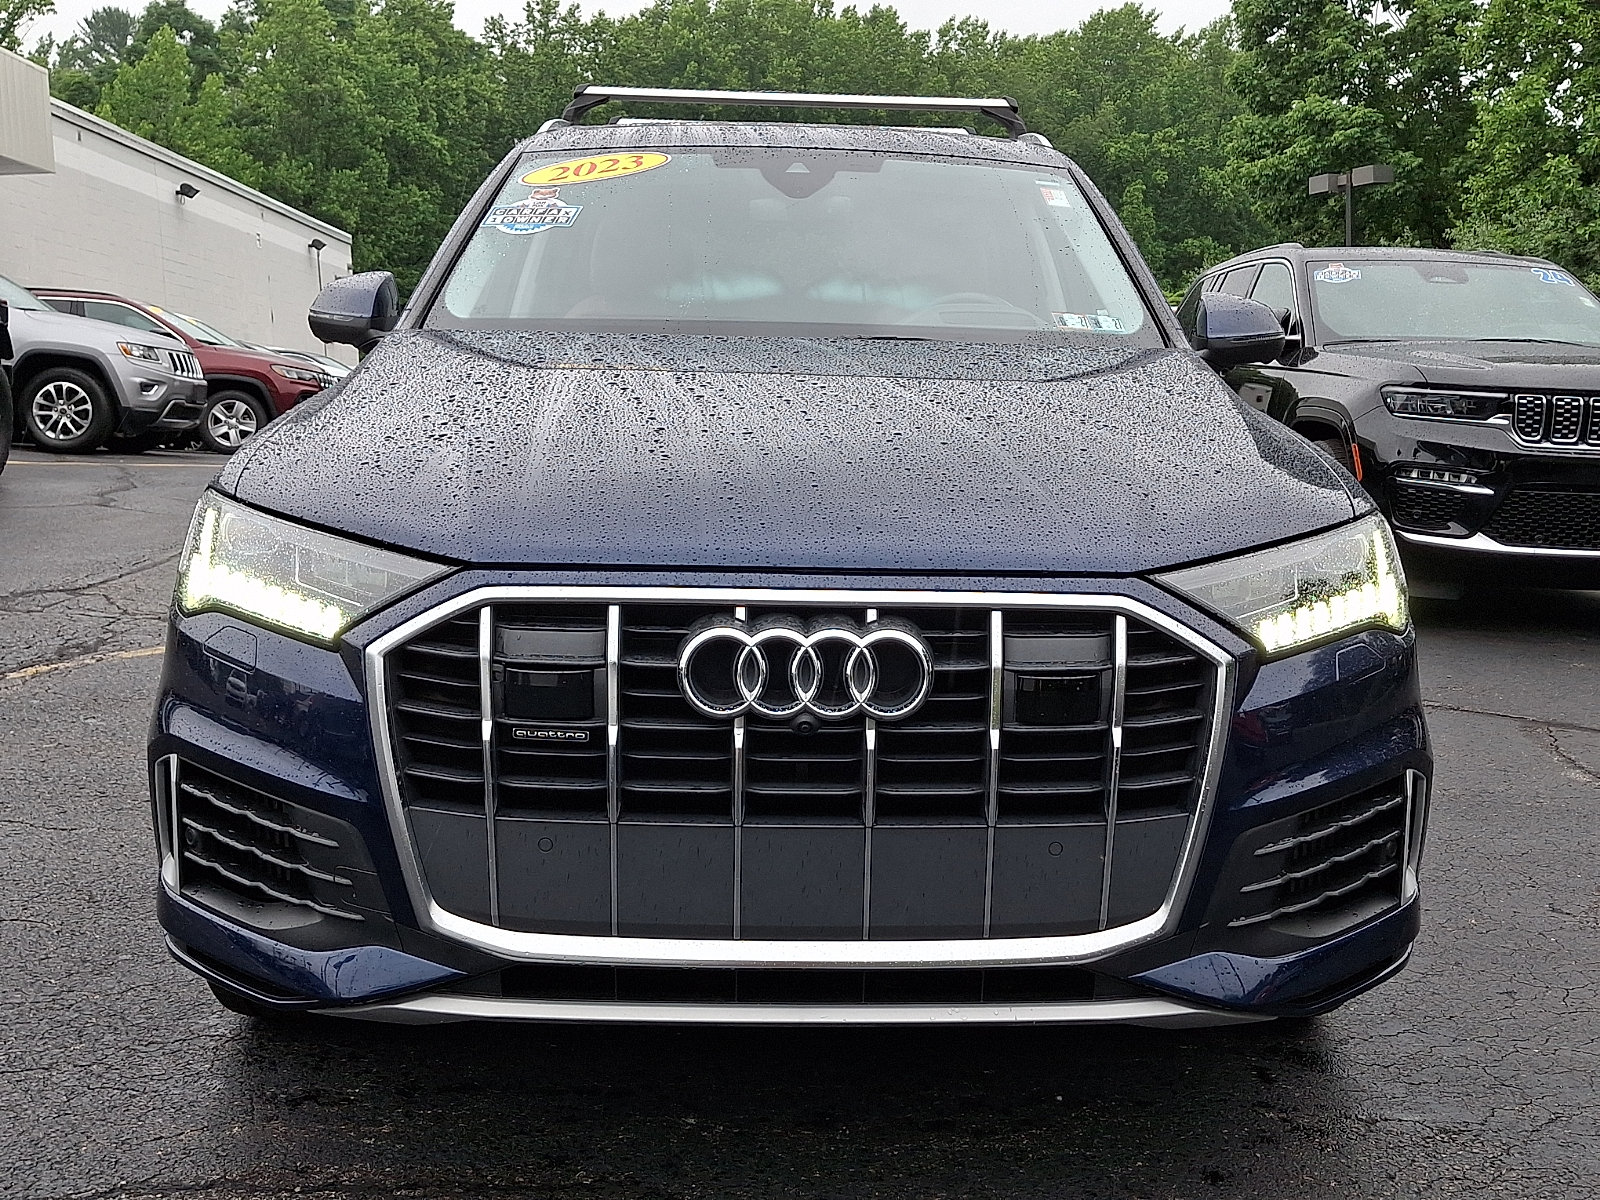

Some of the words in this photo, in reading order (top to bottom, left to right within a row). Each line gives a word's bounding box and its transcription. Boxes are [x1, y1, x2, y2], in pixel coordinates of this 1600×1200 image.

[547, 155, 644, 182] 2023
[493, 207, 573, 216] CARFAX
[501, 216, 570, 224] OWNER
[1531, 268, 1575, 286] 24
[515, 730, 586, 739] quattro
